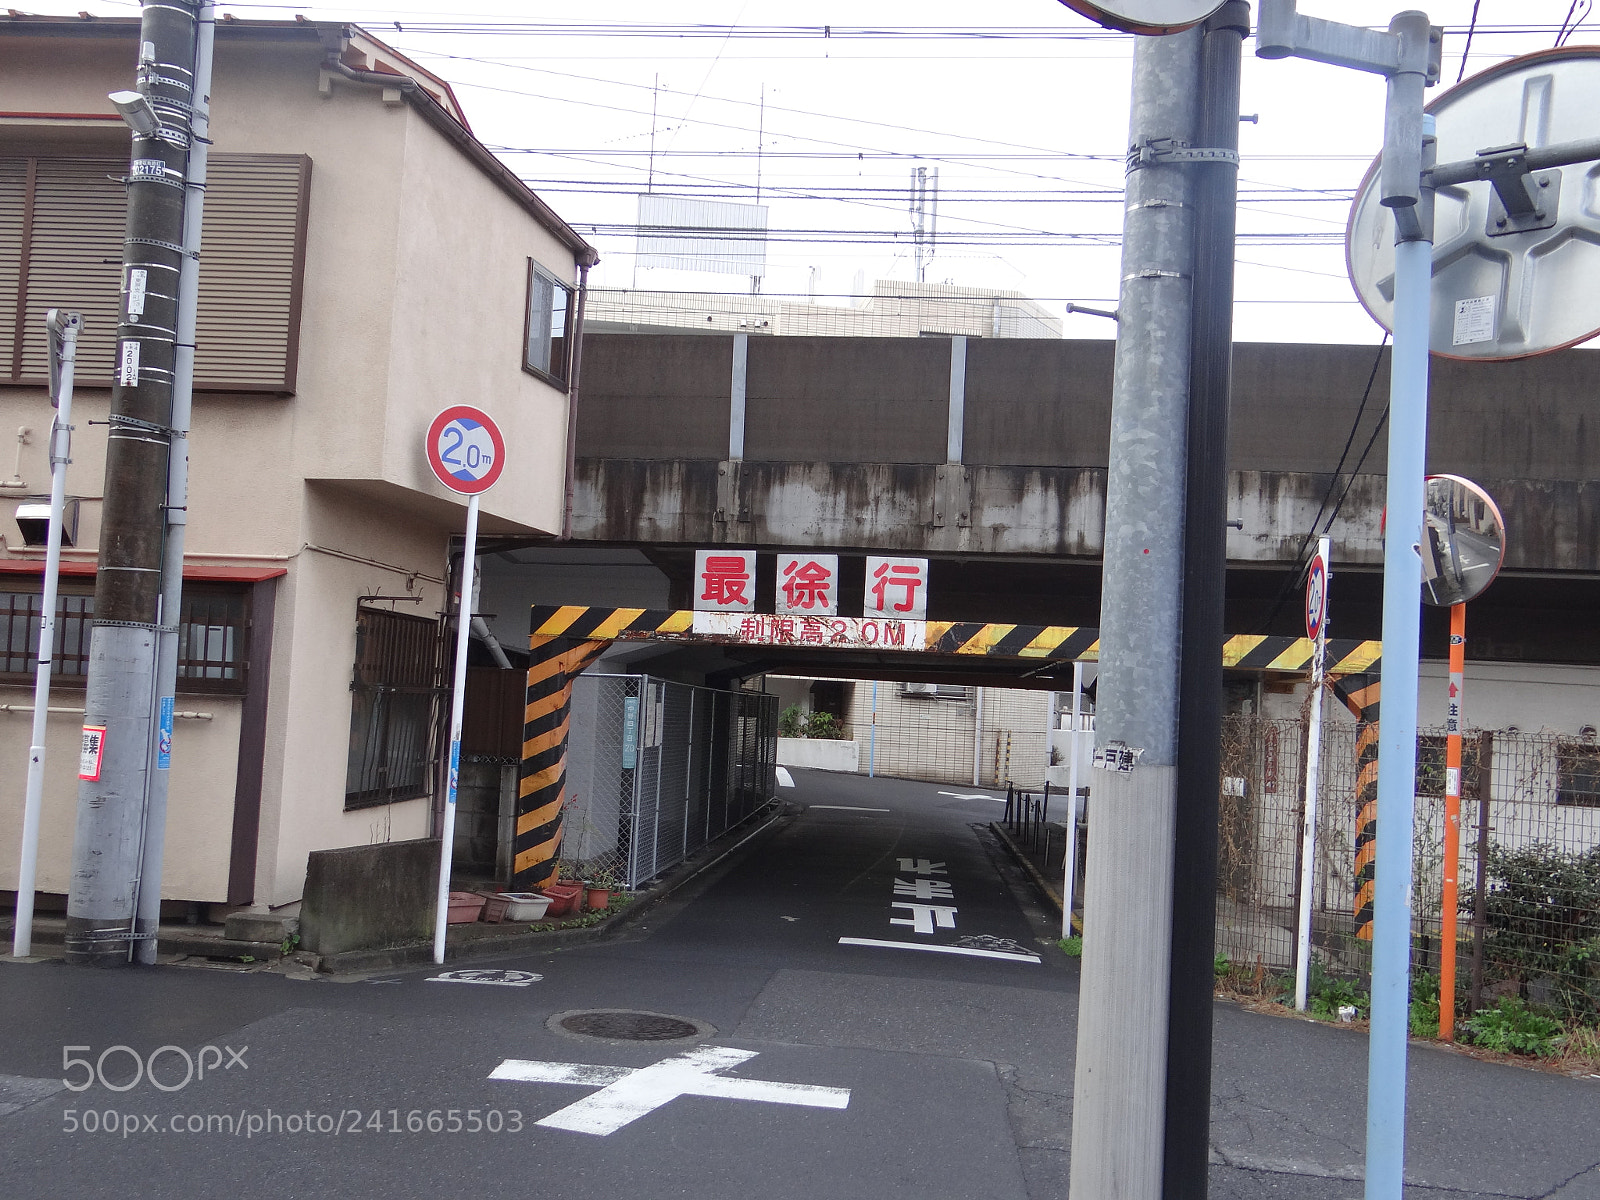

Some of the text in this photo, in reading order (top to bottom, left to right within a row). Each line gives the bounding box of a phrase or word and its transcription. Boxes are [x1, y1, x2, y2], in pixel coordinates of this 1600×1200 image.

[441, 426, 492, 469] 2.0m
[701, 556, 922, 613] 最徐行
[1447, 703, 1458, 732] 注意
